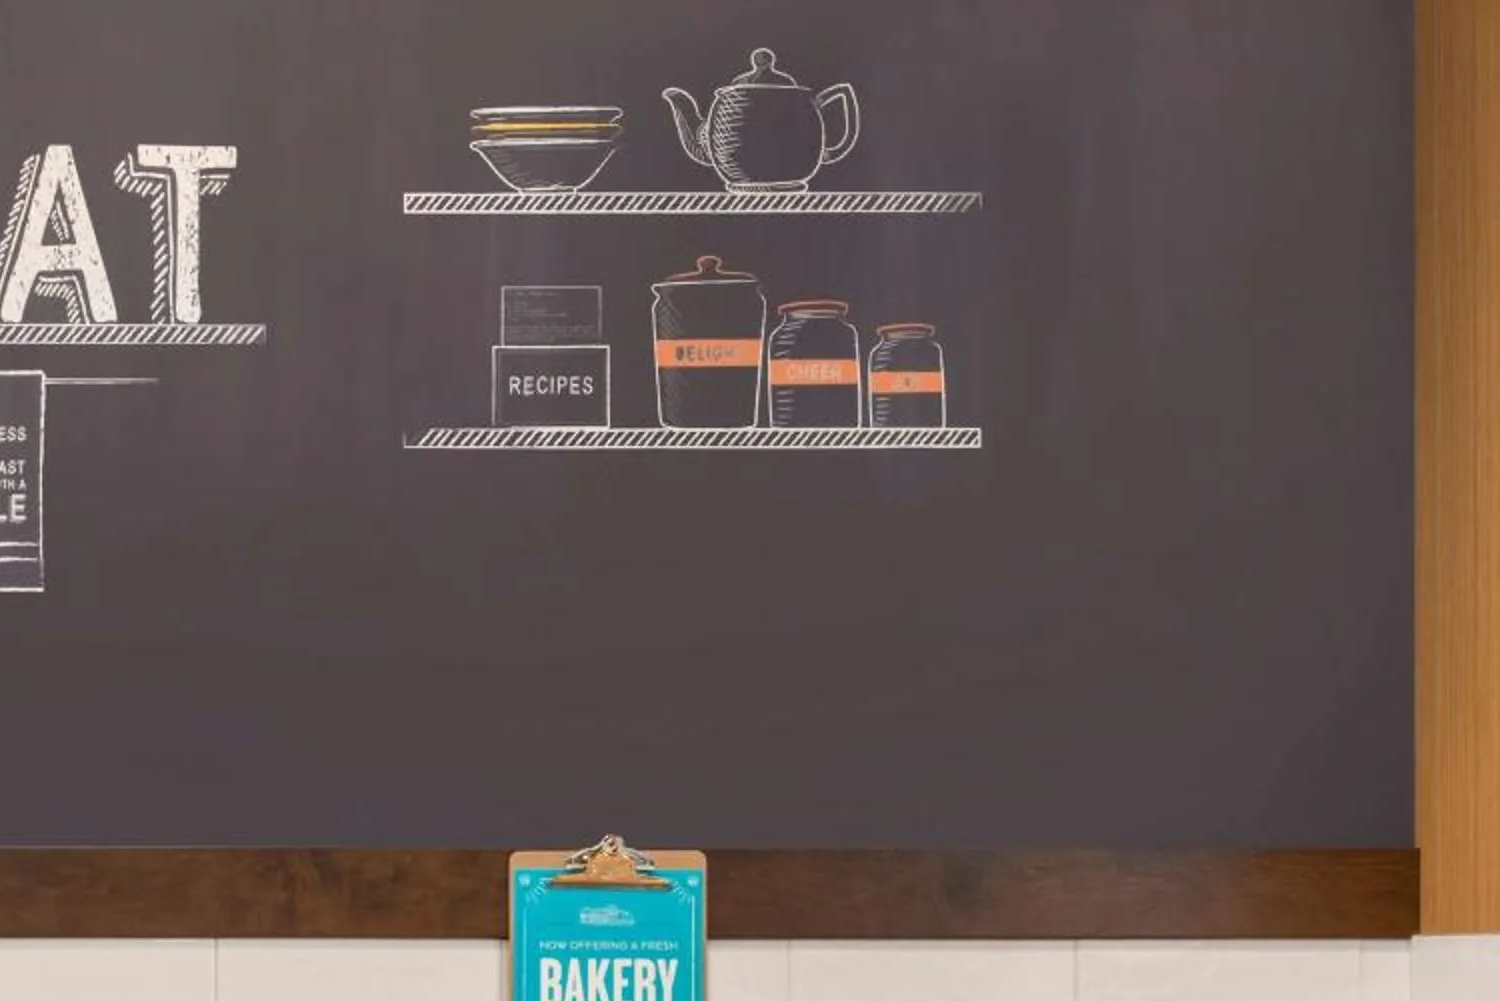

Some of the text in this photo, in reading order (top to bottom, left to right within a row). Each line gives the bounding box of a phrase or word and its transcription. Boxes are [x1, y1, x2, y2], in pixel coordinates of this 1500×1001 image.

[785, 364, 842, 380] CHEER
[509, 375, 594, 396] RECIPES
[18, 479, 27, 490] A
